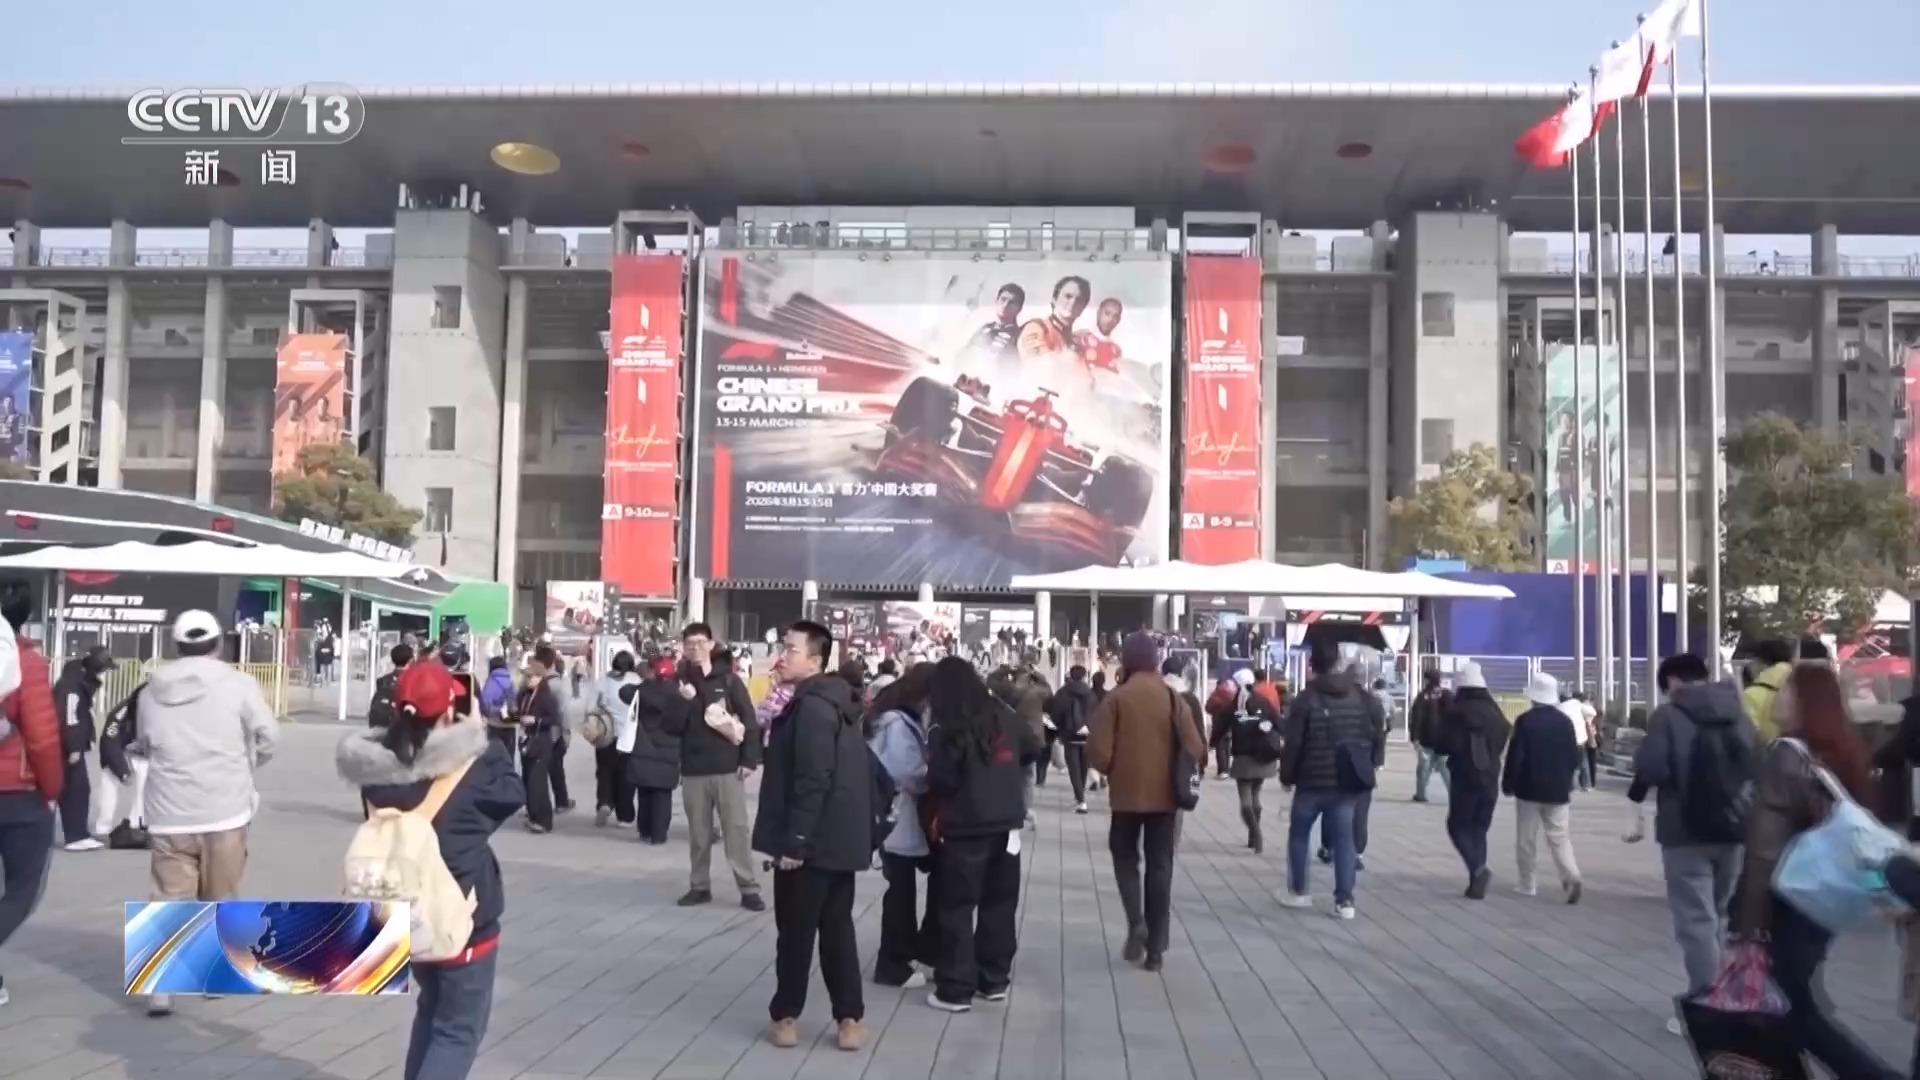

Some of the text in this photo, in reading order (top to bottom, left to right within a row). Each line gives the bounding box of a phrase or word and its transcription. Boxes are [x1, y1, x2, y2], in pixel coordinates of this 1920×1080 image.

[717, 364, 764, 373] FORMULA
[716, 377, 818, 394] CHINESE
[716, 395, 862, 414] GRAND PRIX
[716, 417, 747, 427] 13-15
[748, 418, 794, 428] MARCH
[745, 481, 824, 494] FORMULA
[624, 506, 652, 518] 9-10
[71, 607, 112, 620] REAL
